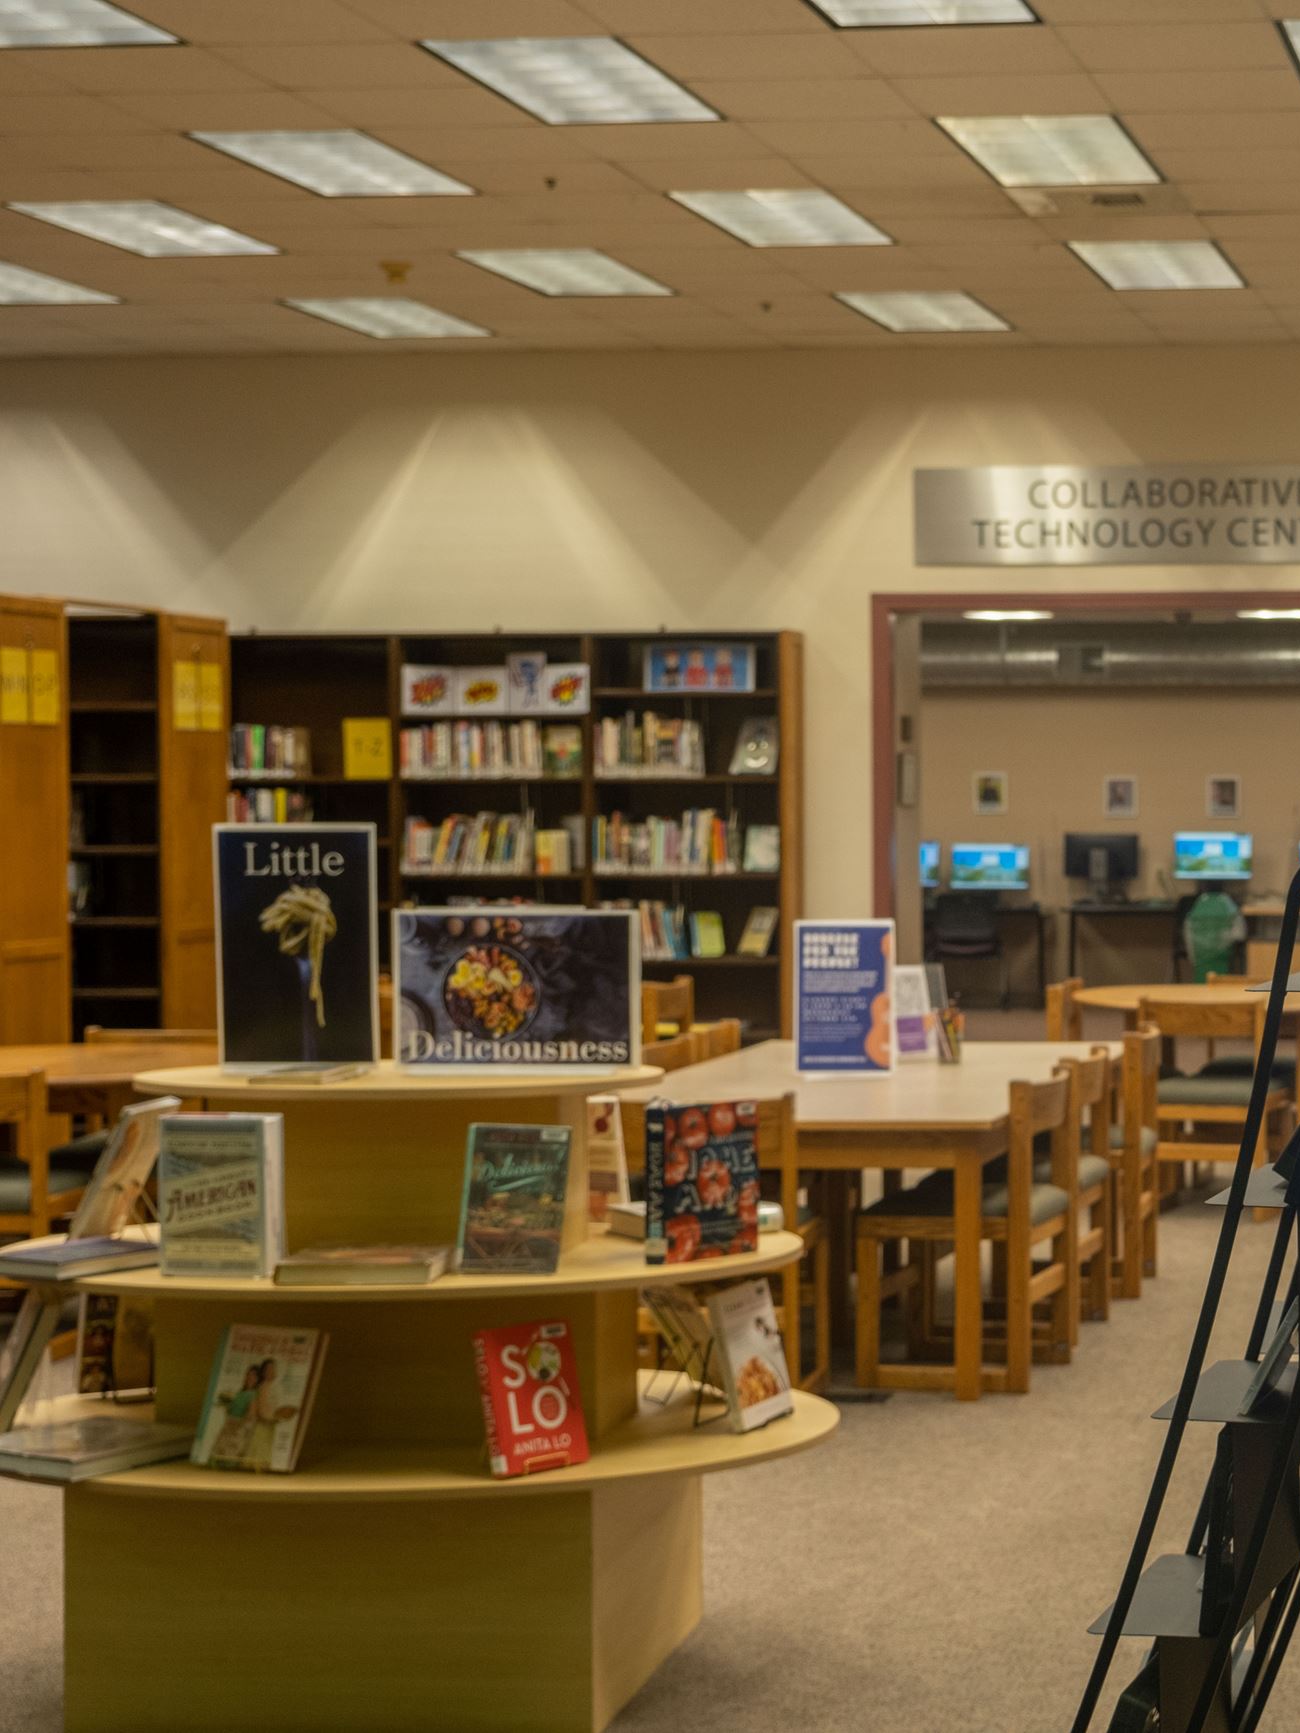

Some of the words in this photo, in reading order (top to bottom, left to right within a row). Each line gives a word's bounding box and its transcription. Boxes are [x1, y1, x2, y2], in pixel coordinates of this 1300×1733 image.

[972, 518, 1216, 549] TECHNOLOGY
[243, 842, 345, 878] Little
[408, 1030, 628, 1063] Deliciousness
[513, 1437, 552, 1456] ANITA
[552, 1432, 572, 1449] LO
